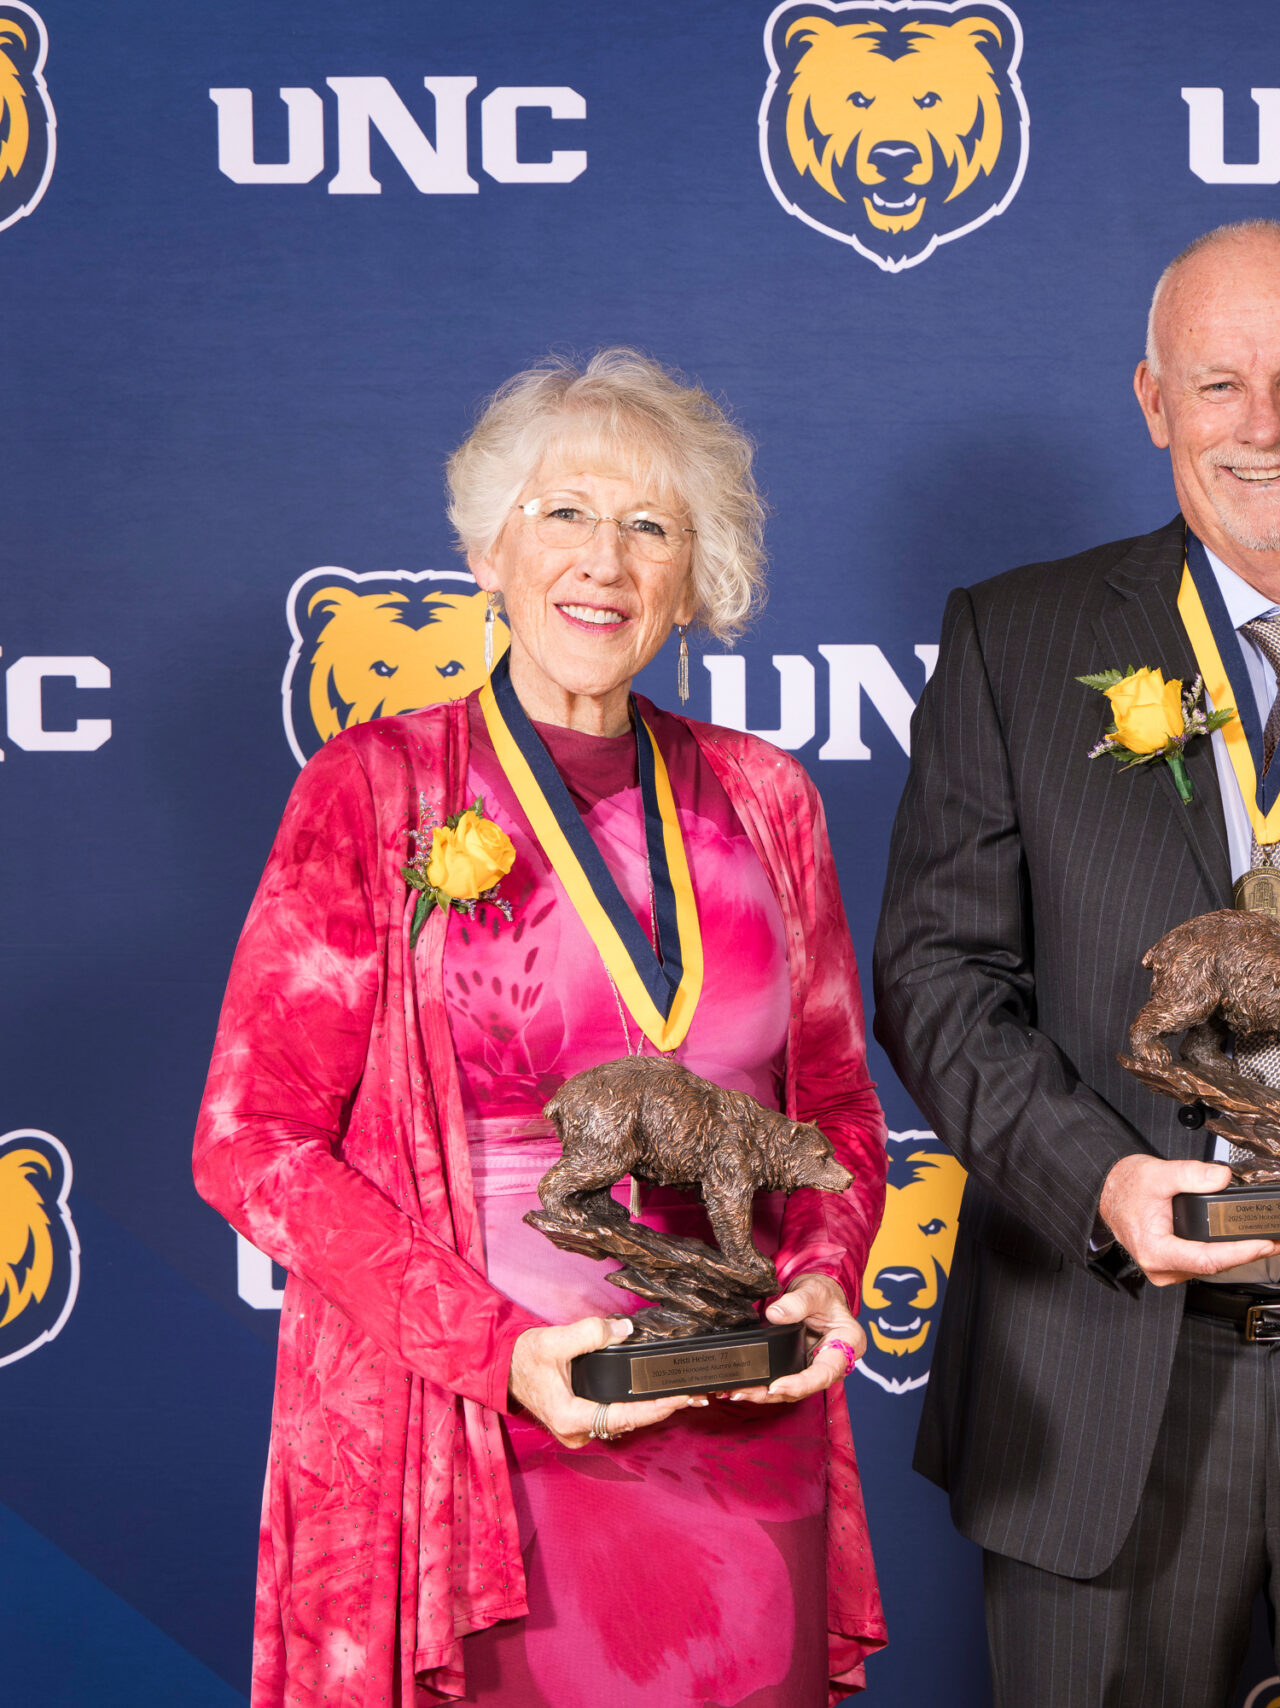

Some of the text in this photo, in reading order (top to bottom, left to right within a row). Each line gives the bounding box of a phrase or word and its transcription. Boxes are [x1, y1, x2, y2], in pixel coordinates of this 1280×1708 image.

[209, 76, 588, 197] UNC
[702, 644, 940, 761] UN
[1236, 1205, 1254, 1213] Dave
